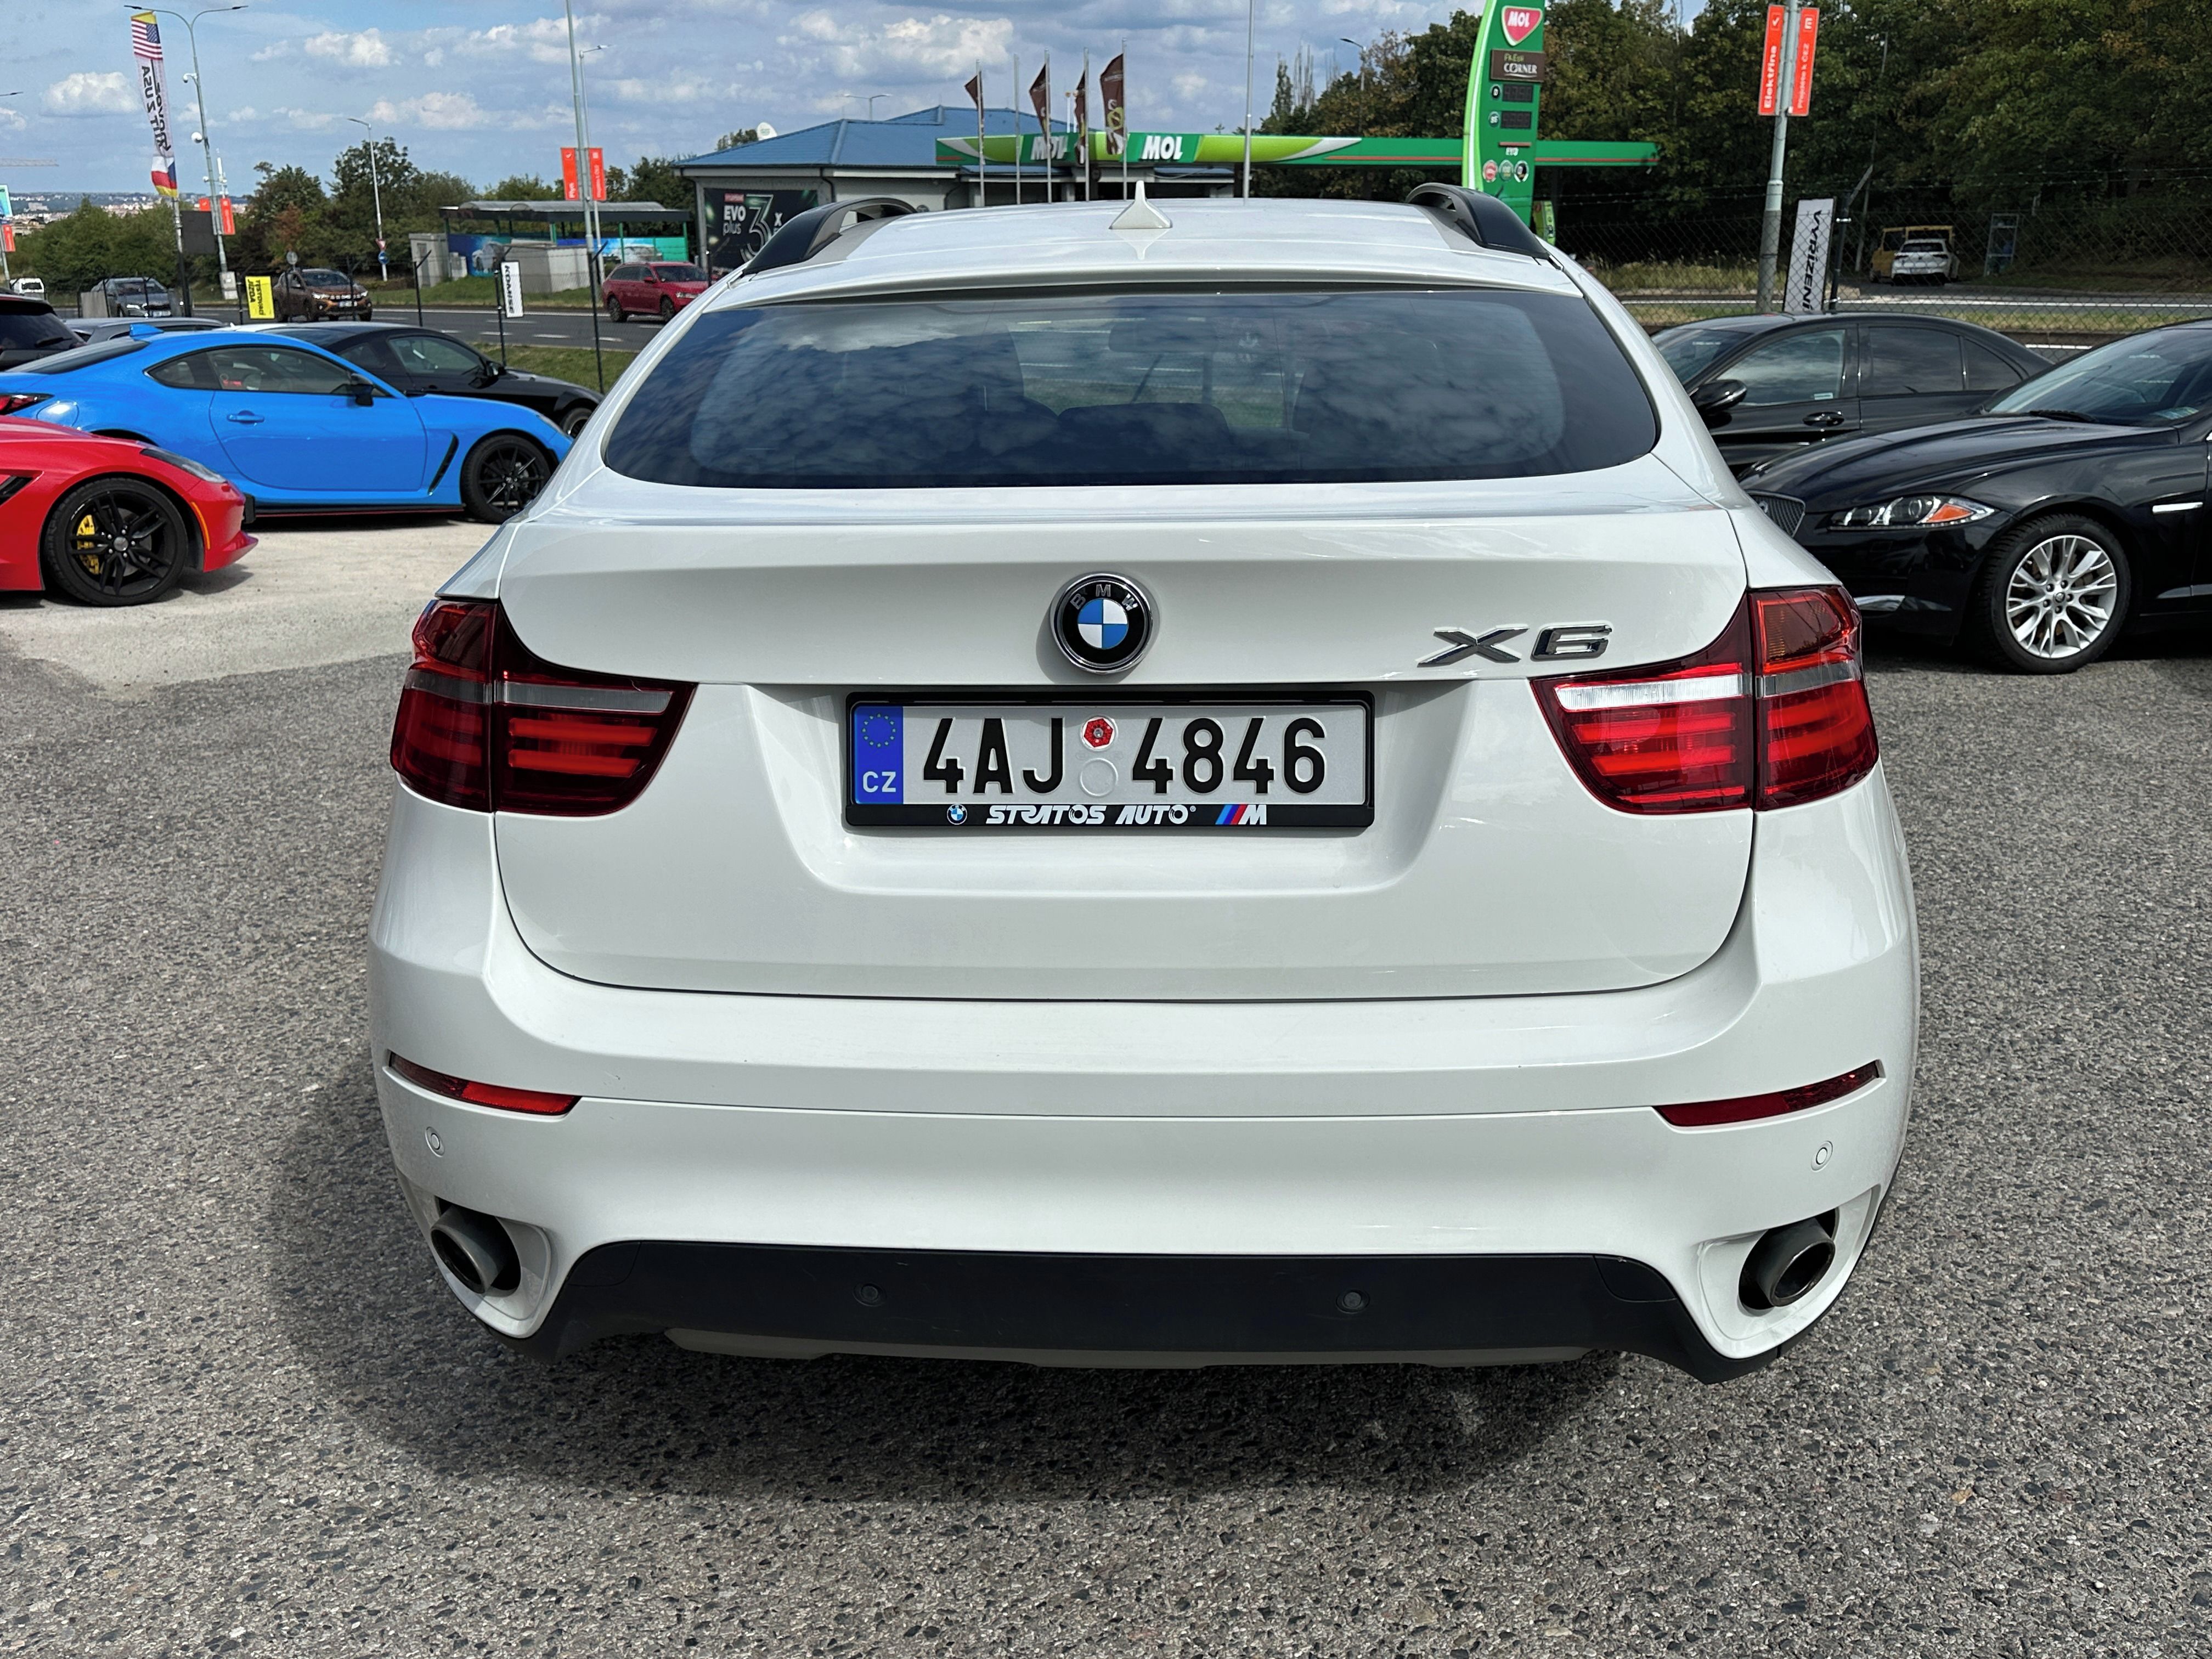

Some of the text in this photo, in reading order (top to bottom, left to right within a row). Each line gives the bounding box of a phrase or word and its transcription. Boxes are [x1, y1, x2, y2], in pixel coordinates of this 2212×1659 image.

[1508, 11, 1530, 27] MOL
[1503, 63, 1537, 74] CORNER
[1763, 46, 1777, 108] Elektřina
[1141, 135, 1183, 160] MOL
[724, 205, 746, 222] EVO
[723, 220, 742, 236] plus
[1803, 210, 1821, 310] VYŘÍZENÍ
[1070, 584, 1138, 611] BMW
[1417, 623, 1612, 668] X6
[923, 718, 1325, 794] 4AJ 4846
[862, 771, 896, 793] CZ
[986, 805, 1106, 825] STRATOS
